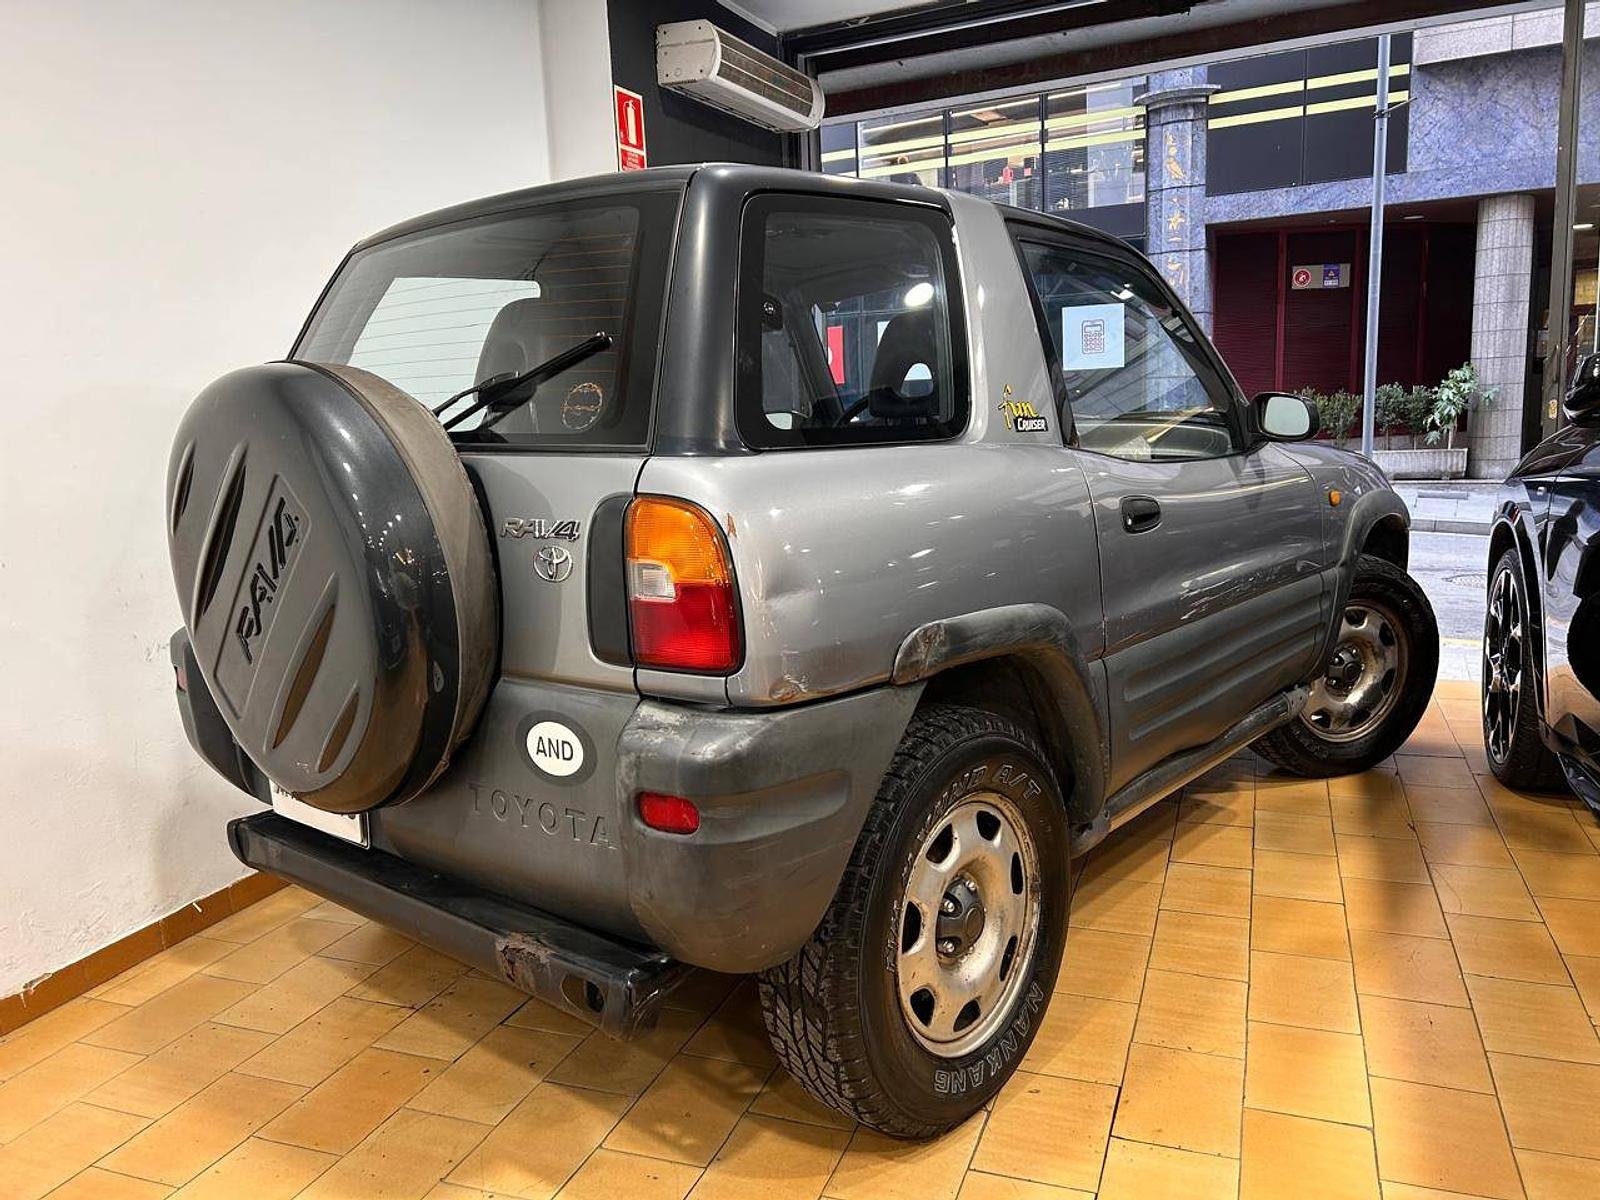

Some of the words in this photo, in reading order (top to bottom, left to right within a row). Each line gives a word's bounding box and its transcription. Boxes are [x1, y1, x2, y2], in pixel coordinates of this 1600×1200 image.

[500, 517, 580, 542] RAV4
[535, 736, 574, 762] AND
[468, 782, 618, 850] TOYOTA
[934, 980, 1045, 1094] NANKANG
